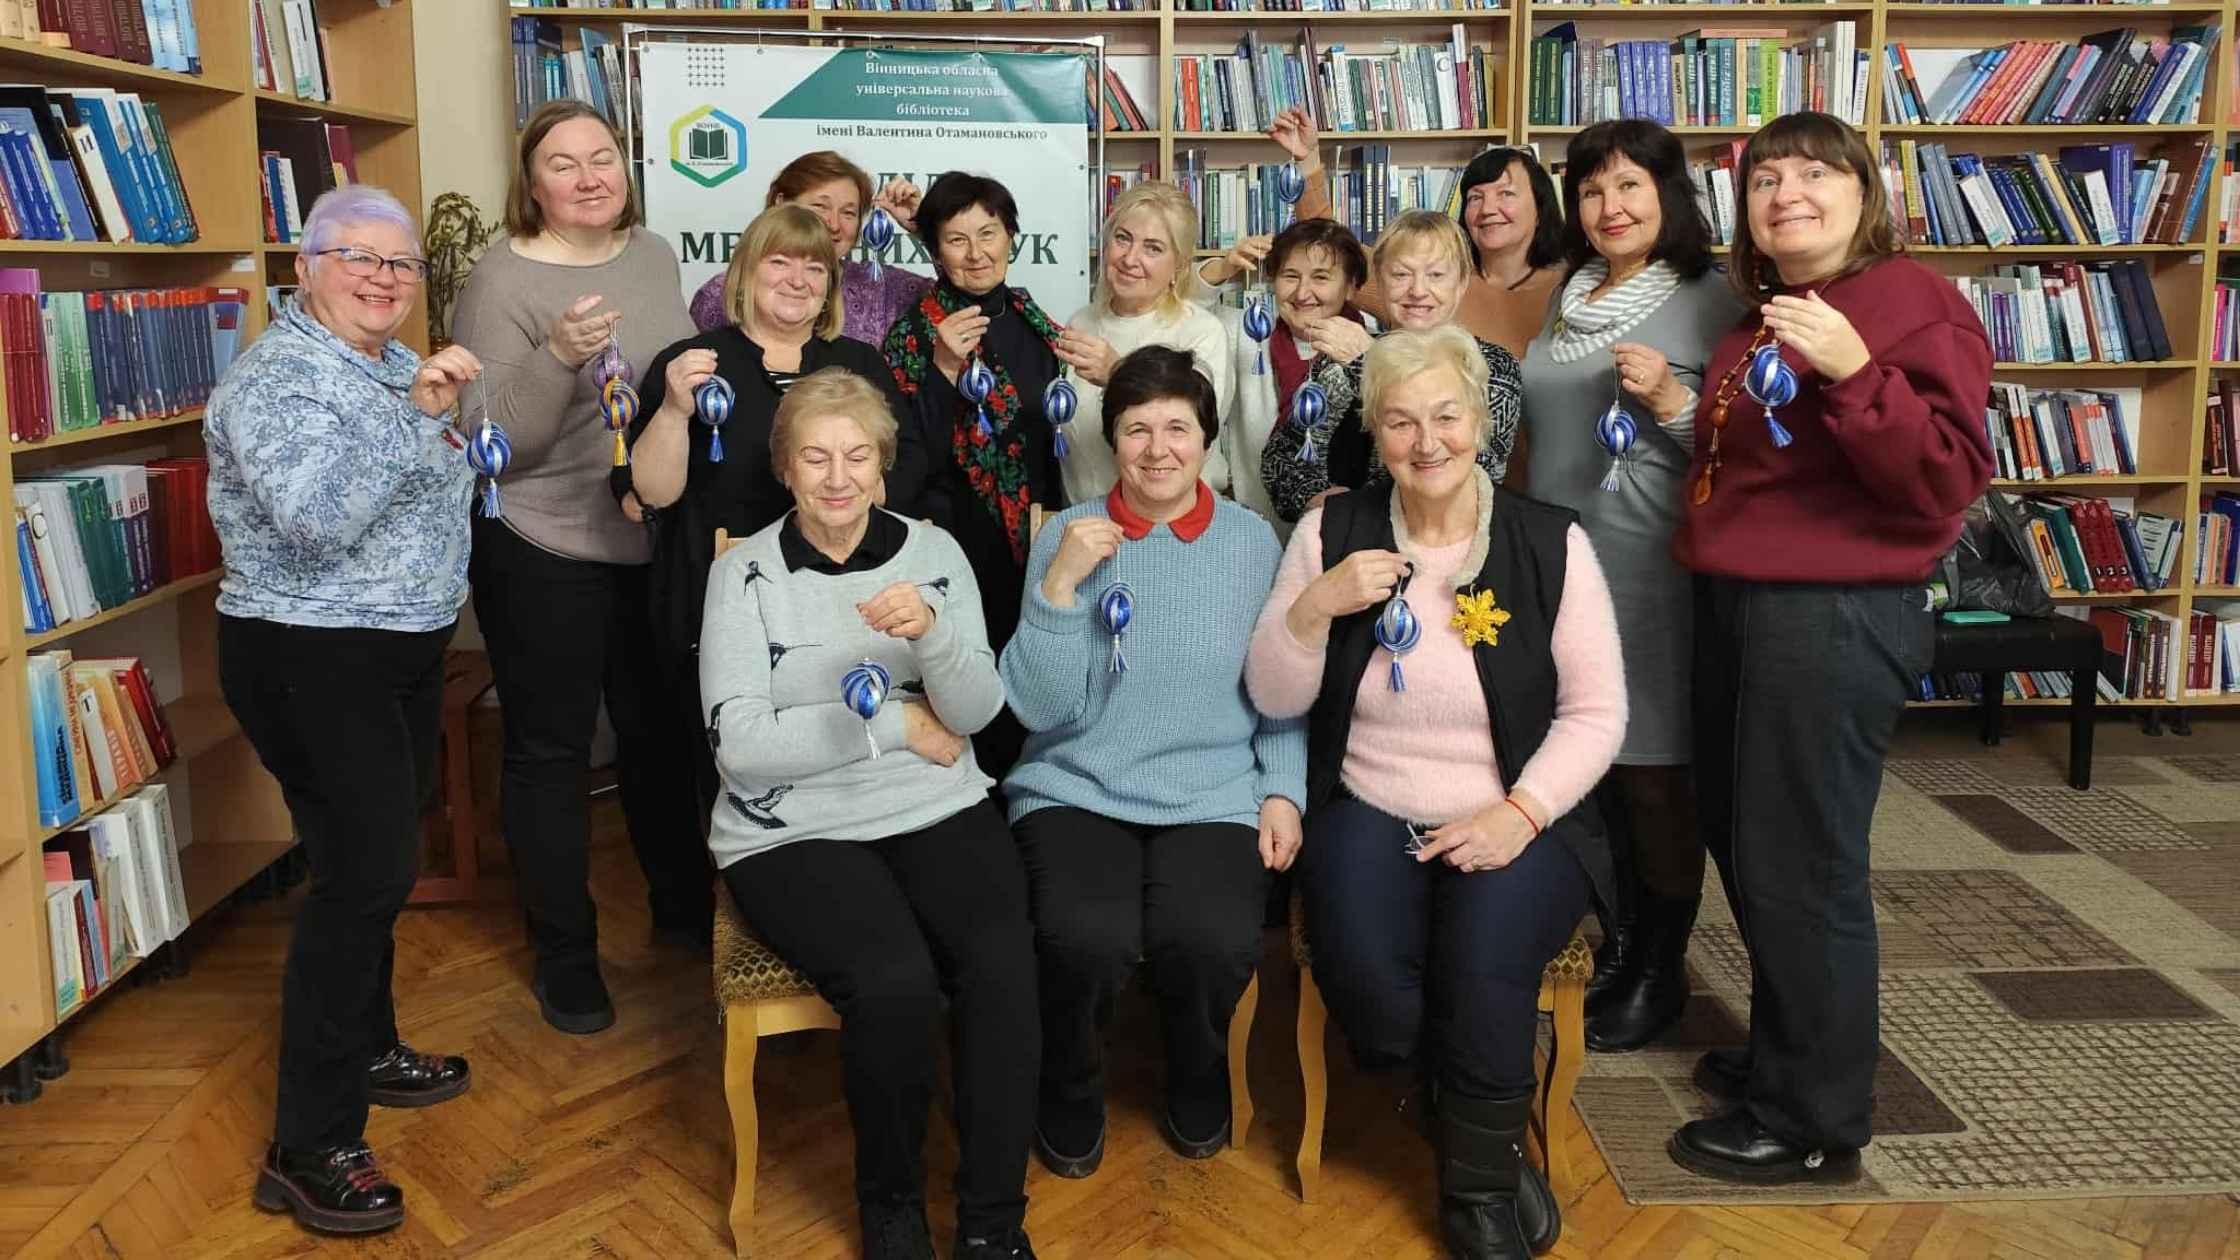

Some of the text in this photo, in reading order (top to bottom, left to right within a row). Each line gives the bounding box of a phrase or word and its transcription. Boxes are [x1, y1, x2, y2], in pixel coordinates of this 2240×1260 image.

[864, 62, 999, 77] Вінницька обласна
[855, 82, 1008, 97] універсальна наукова
[896, 103, 970, 117] бібліотека
[816, 124, 1048, 141] імені Валентина Отамановського
